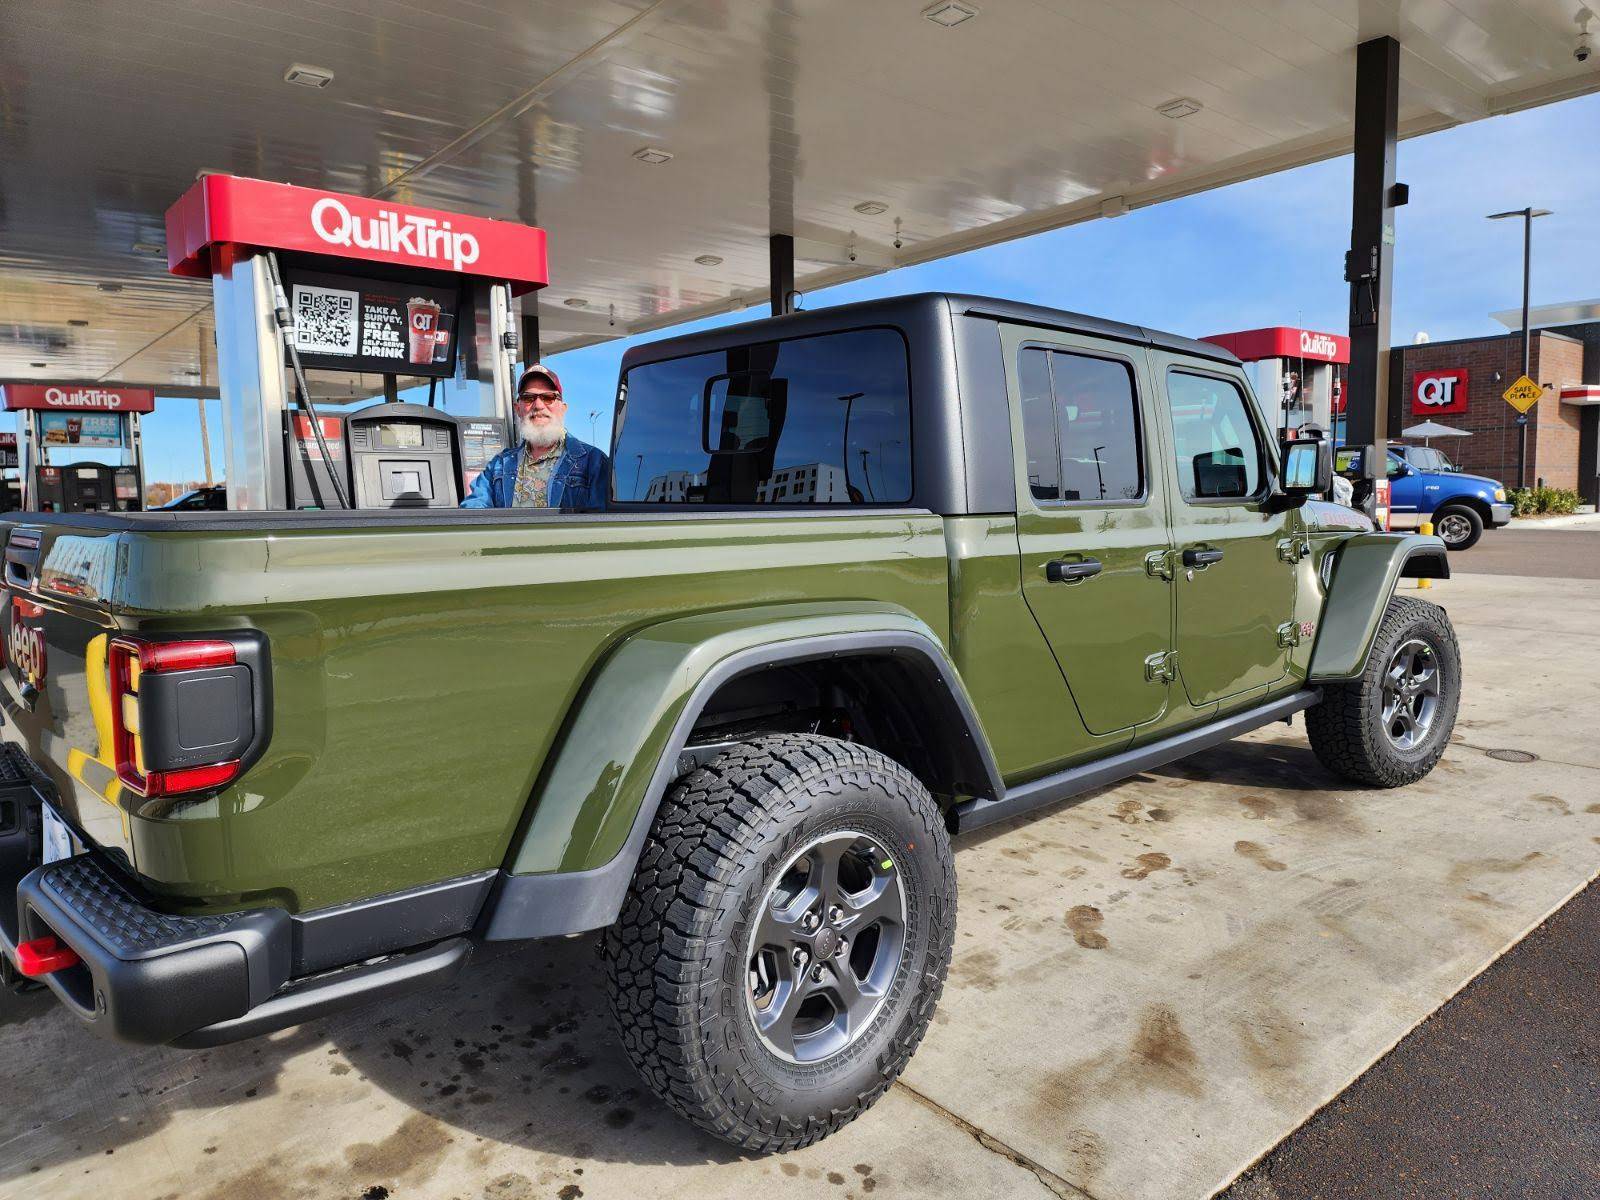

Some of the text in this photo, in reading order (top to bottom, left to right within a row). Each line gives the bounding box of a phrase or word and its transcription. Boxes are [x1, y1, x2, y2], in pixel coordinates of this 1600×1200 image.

[311, 198, 480, 272] QuikTrip
[364, 305, 389, 315] TAKE
[363, 321, 392, 331] GET A
[364, 313, 403, 326] SURVEY,
[413, 313, 433, 330] QT
[363, 329, 400, 342] FREE
[362, 340, 405, 349] SELF-SERVE
[1301, 332, 1337, 360] QuikTrip
[361, 346, 405, 360] DRINK
[1417, 376, 1458, 406] QT
[1514, 385, 1533, 393] SAFE
[45, 388, 121, 409] QuikTrip
[45, 468, 55, 476] 13
